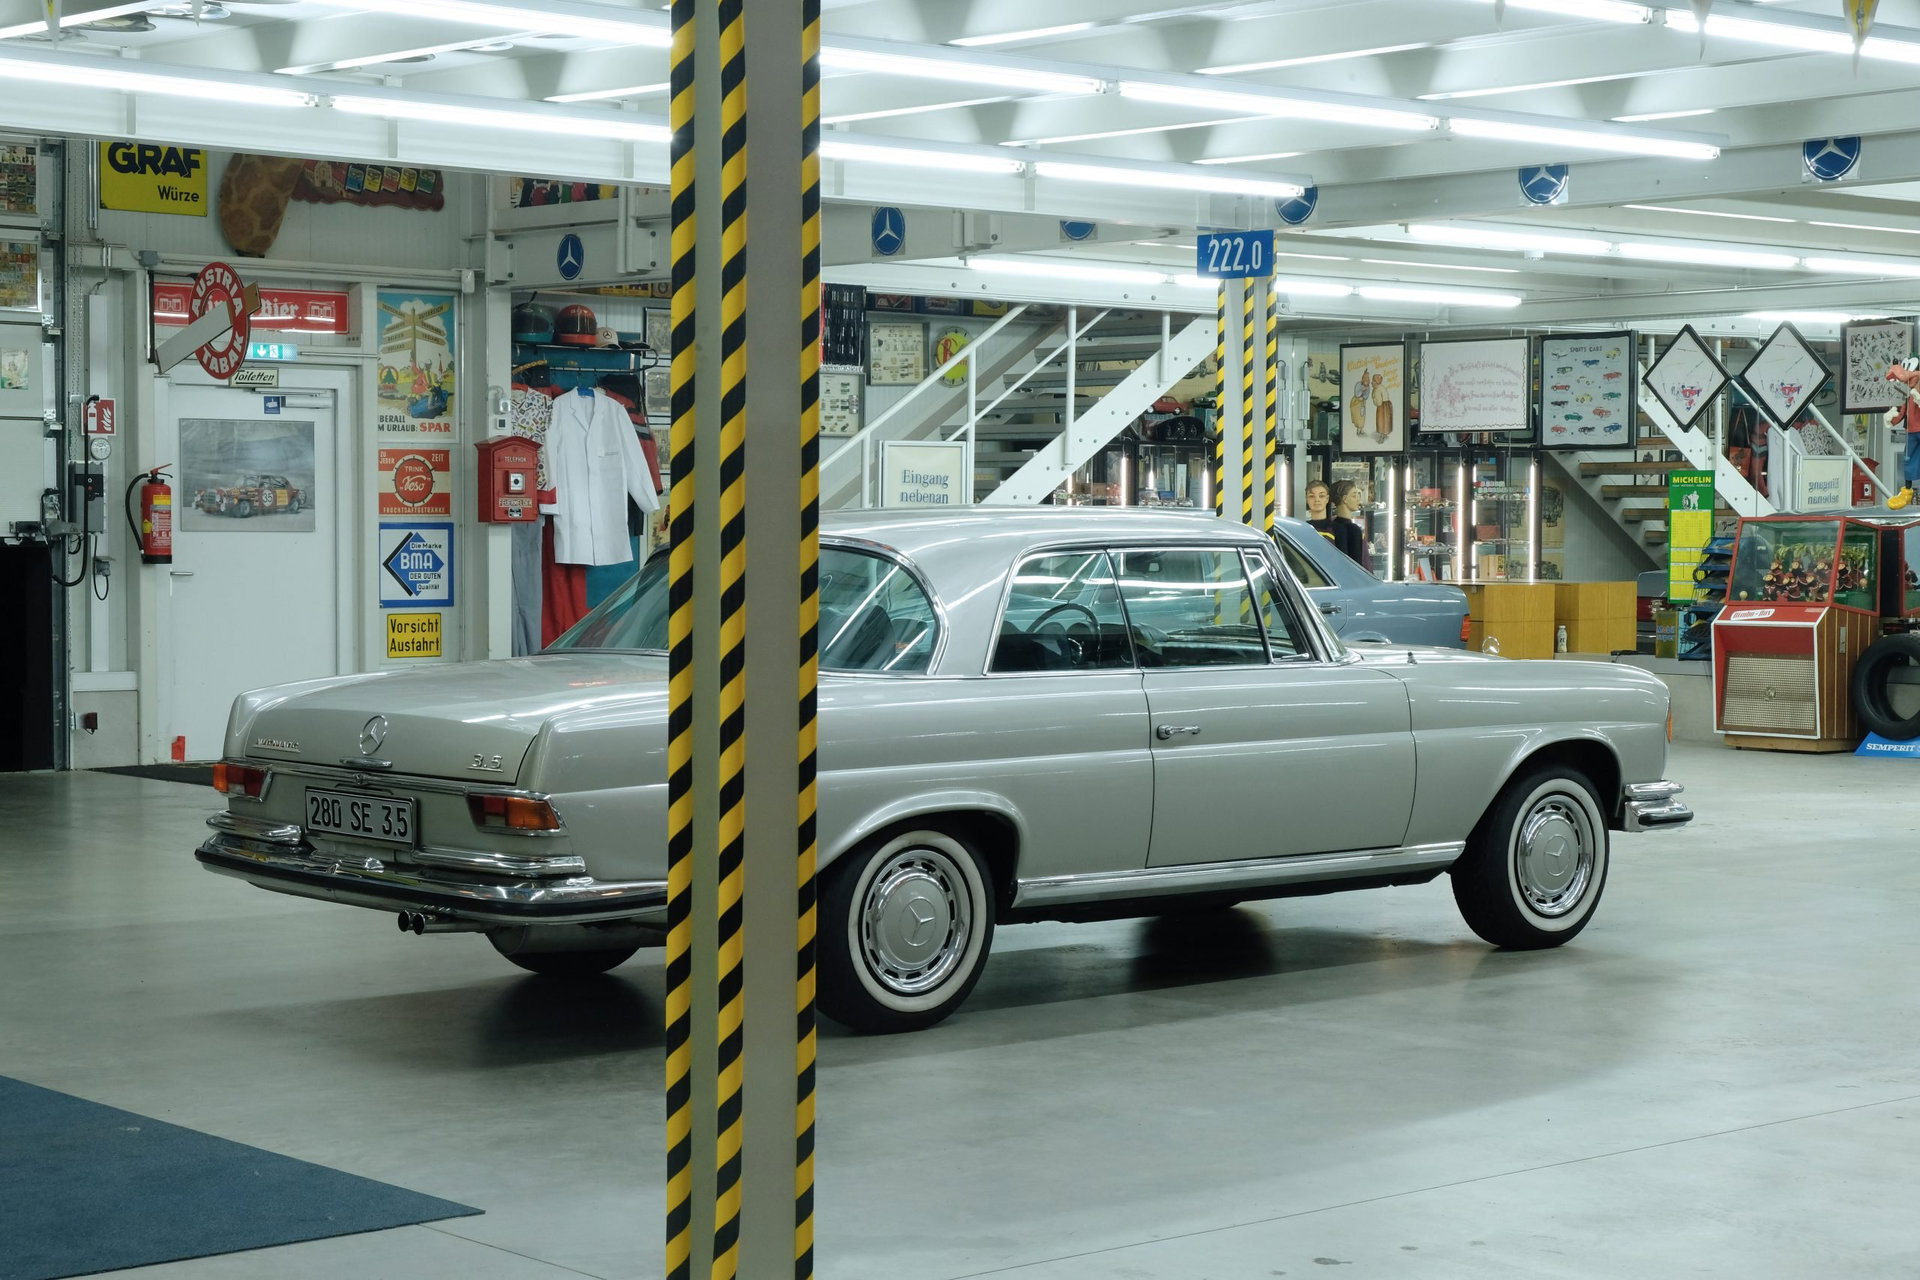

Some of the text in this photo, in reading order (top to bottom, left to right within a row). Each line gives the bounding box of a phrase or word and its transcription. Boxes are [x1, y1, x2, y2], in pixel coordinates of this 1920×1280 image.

[108, 142, 200, 178] GRAF
[157, 185, 199, 203] Würze
[1208, 237, 1262, 275] 222,0
[191, 267, 244, 318] AUSTRIA
[261, 297, 299, 318] Bier
[202, 335, 244, 375] TABAK
[234, 370, 275, 383] Toiletten
[379, 414, 406, 423] BERALL
[420, 422, 452, 433] SPAR
[431, 454, 444, 462] ZEIT
[902, 469, 949, 489] Eingang
[1672, 476, 1711, 484] MICHELIN
[901, 490, 949, 504] nebenan
[423, 542, 443, 550] Marke
[400, 552, 433, 570] BMA
[409, 572, 442, 580] DER GUTEN
[390, 618, 439, 634] Vorsicht
[389, 637, 440, 653] Ausfahrt
[1866, 743, 1915, 752] SEMPERIT
[471, 753, 503, 770] 3.5
[310, 796, 408, 838] 280 SE 3.5
